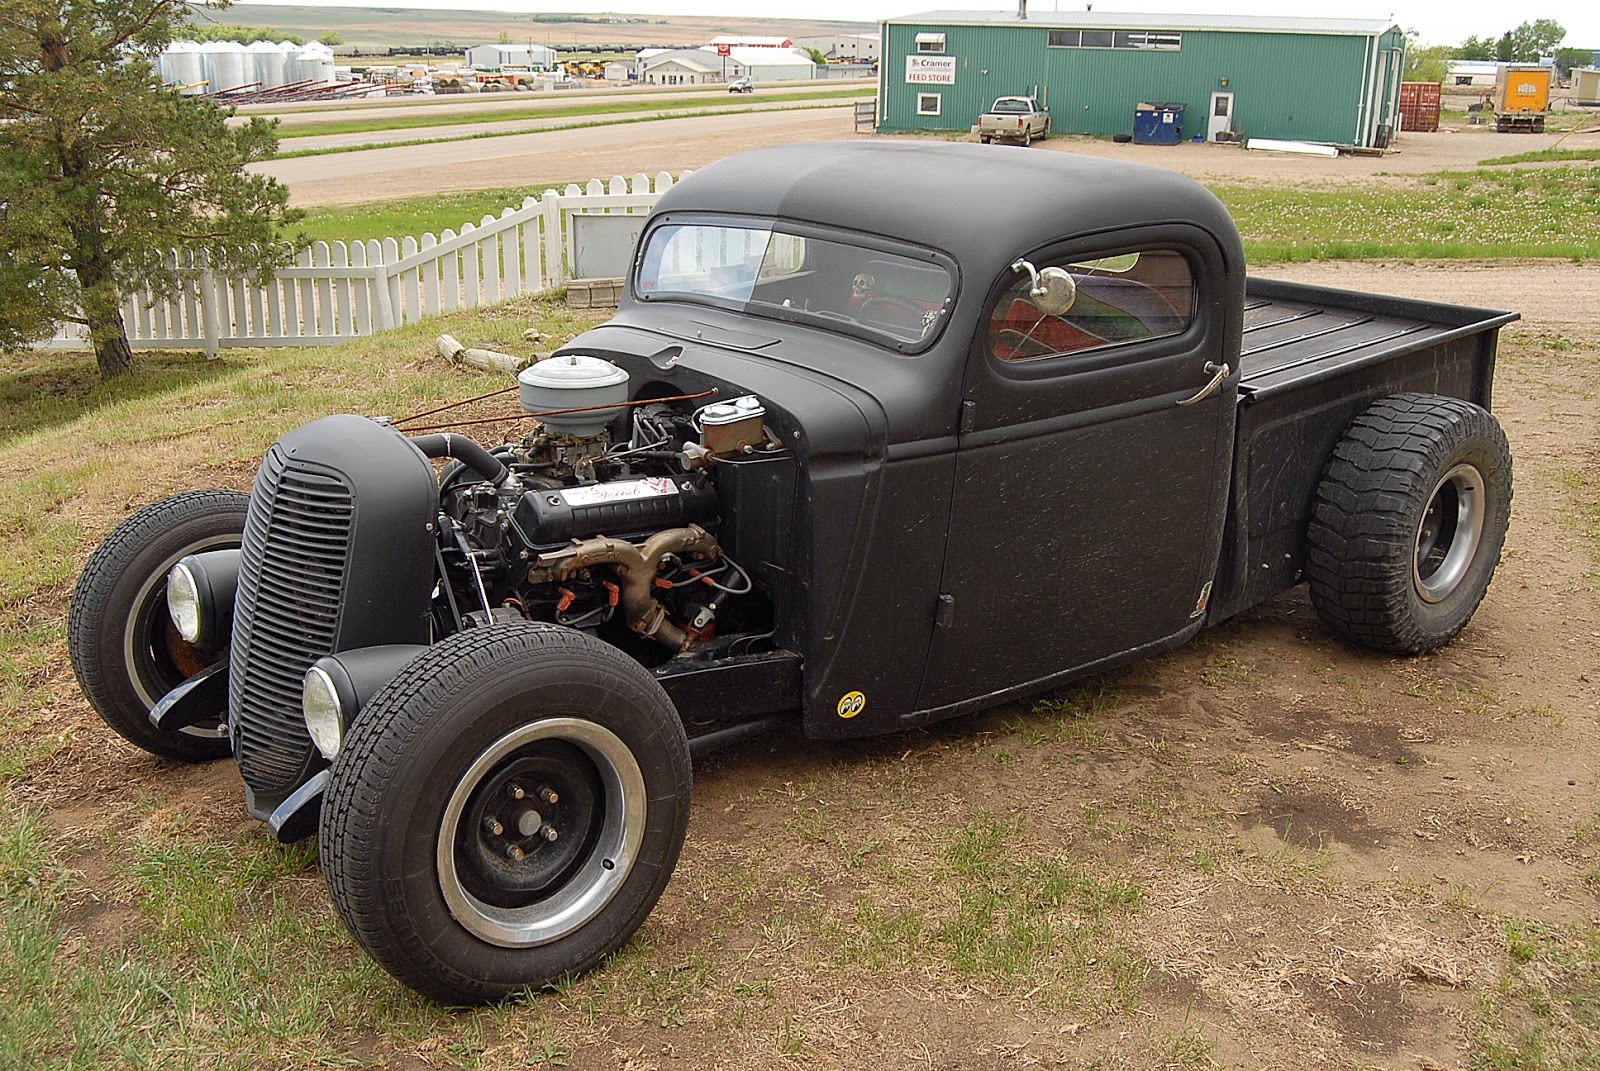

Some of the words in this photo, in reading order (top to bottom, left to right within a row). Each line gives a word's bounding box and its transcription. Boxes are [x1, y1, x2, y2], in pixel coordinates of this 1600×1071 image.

[921, 59, 951, 67] Cramer
[909, 73, 927, 81] FEED
[928, 74, 951, 82] STORE
